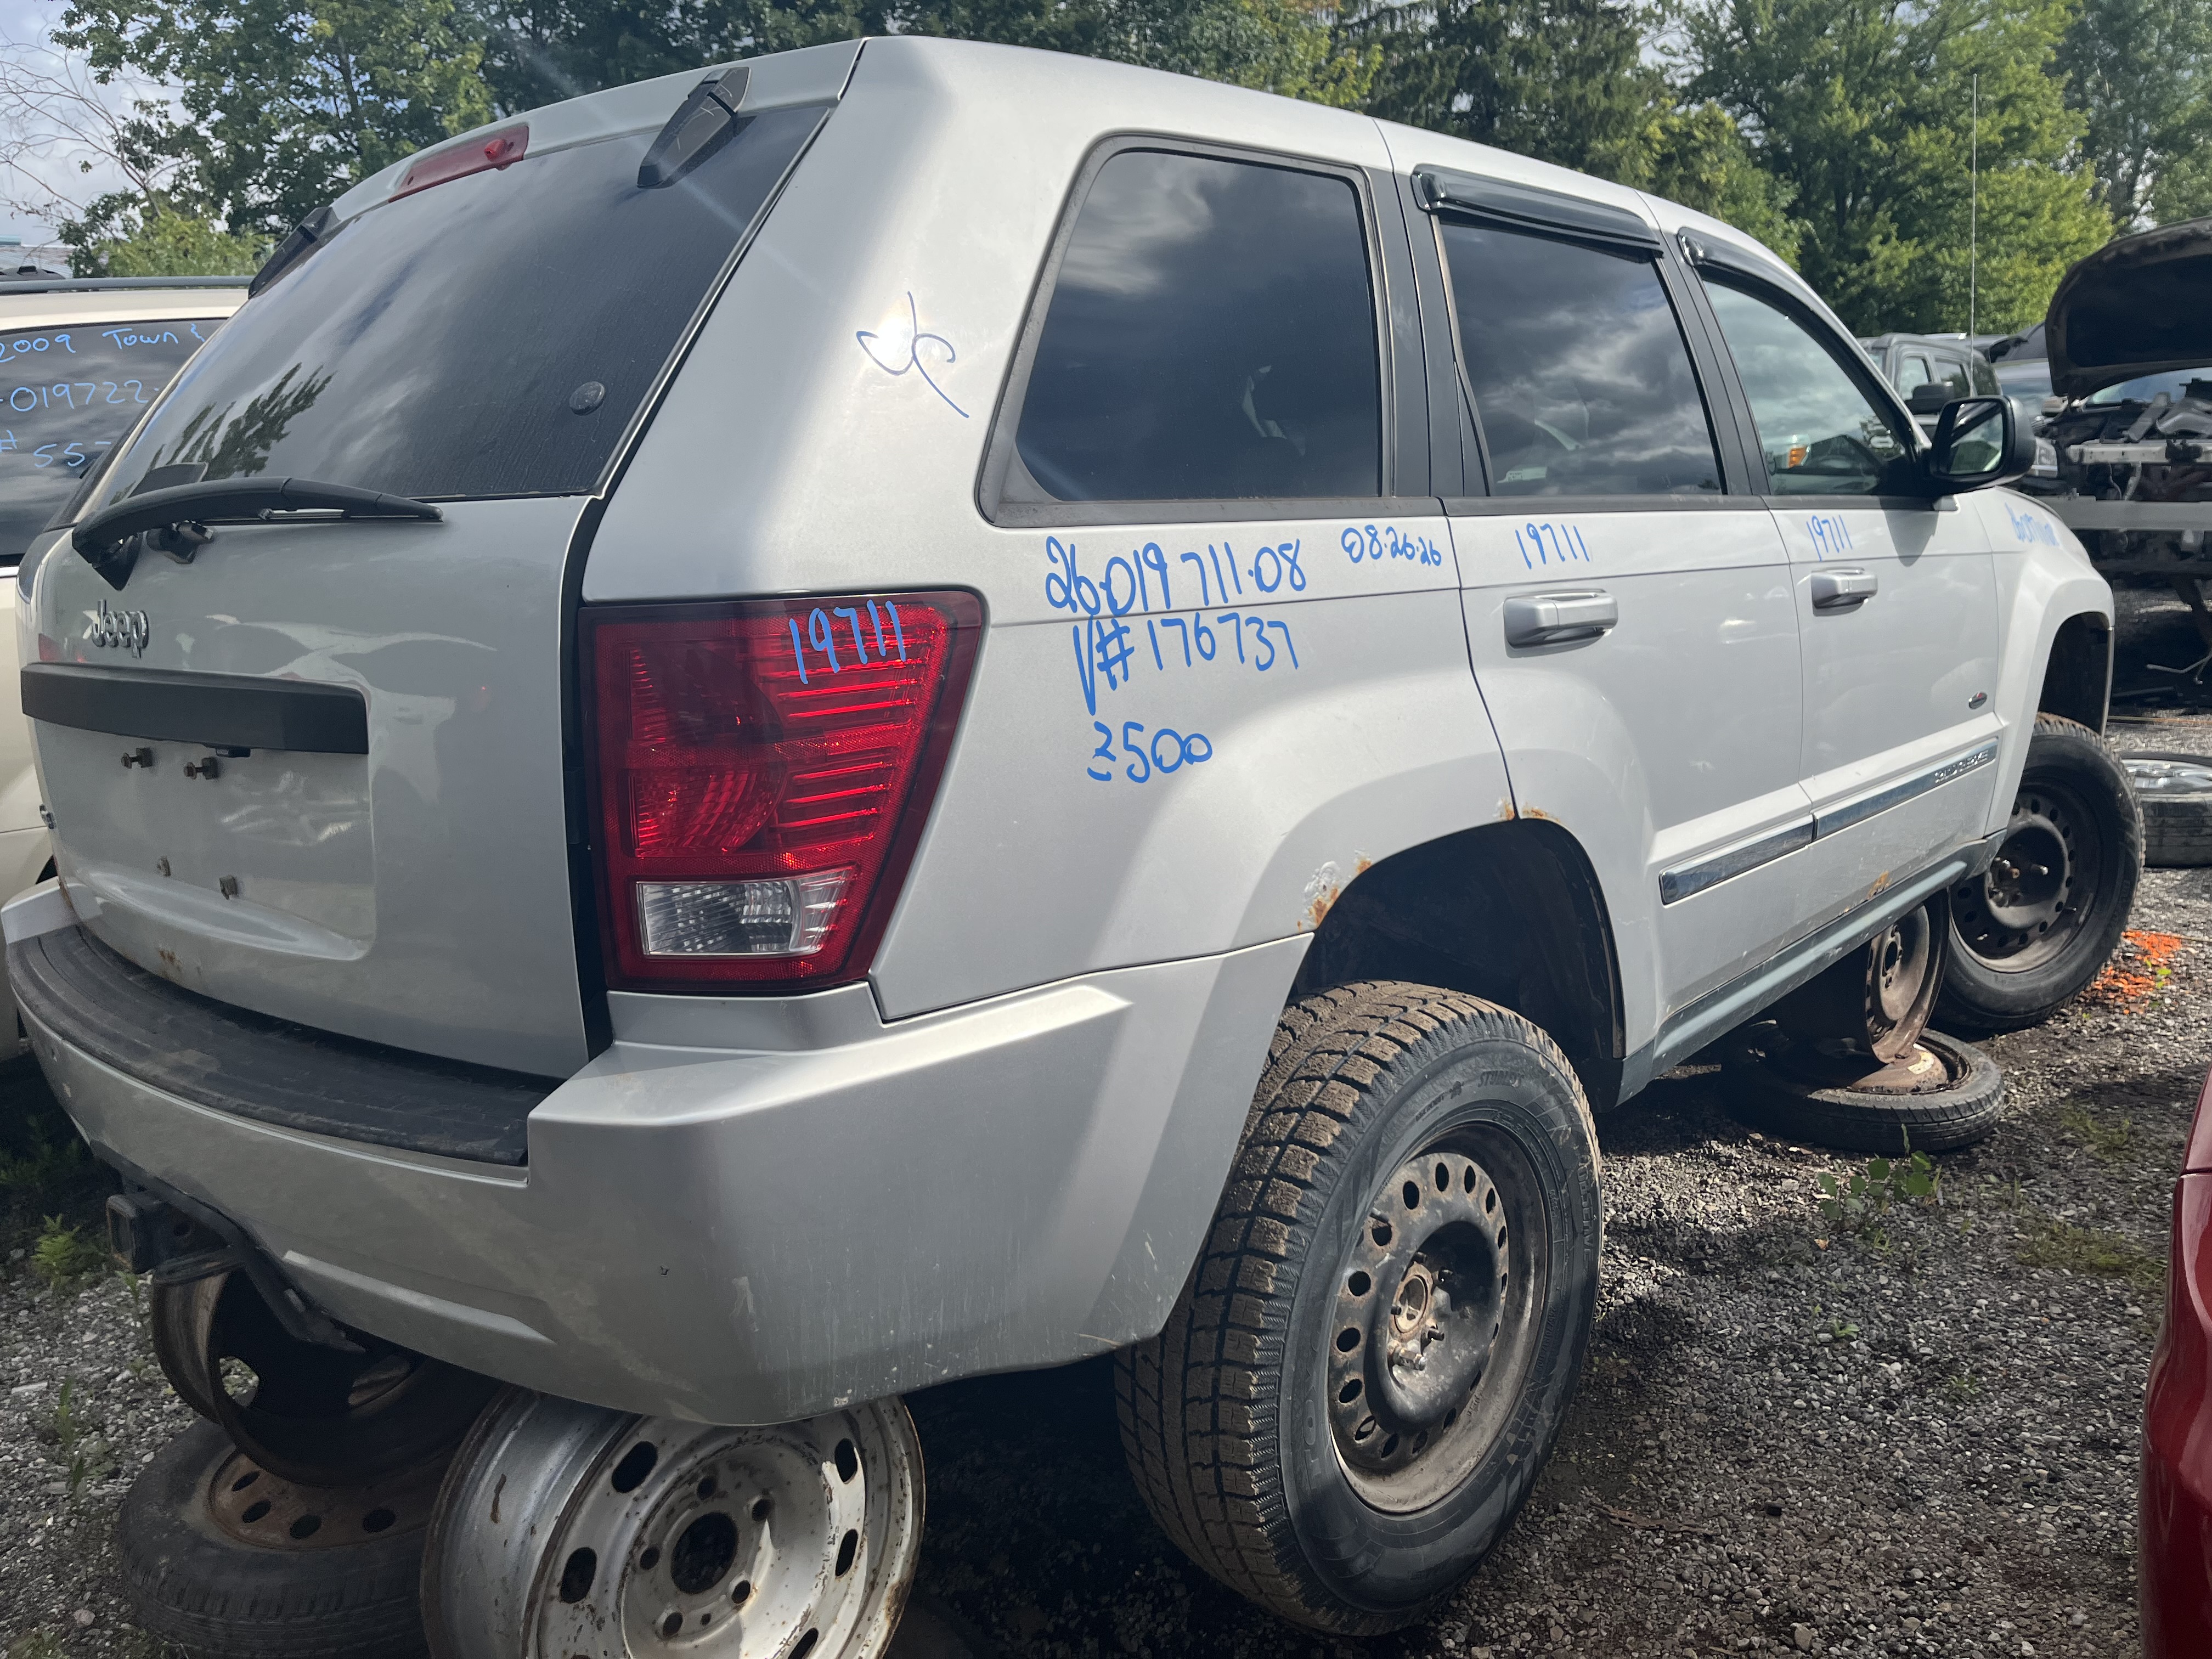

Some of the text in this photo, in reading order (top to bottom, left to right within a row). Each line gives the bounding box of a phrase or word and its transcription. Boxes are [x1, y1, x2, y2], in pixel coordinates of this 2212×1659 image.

[0, 333, 76, 363] 2009
[102, 328, 179, 350] Town
[1515, 523, 1590, 569] 19711
[1805, 514, 1853, 562] 19711
[92, 599, 149, 658] Jeep
[788, 599, 906, 685] 19711
